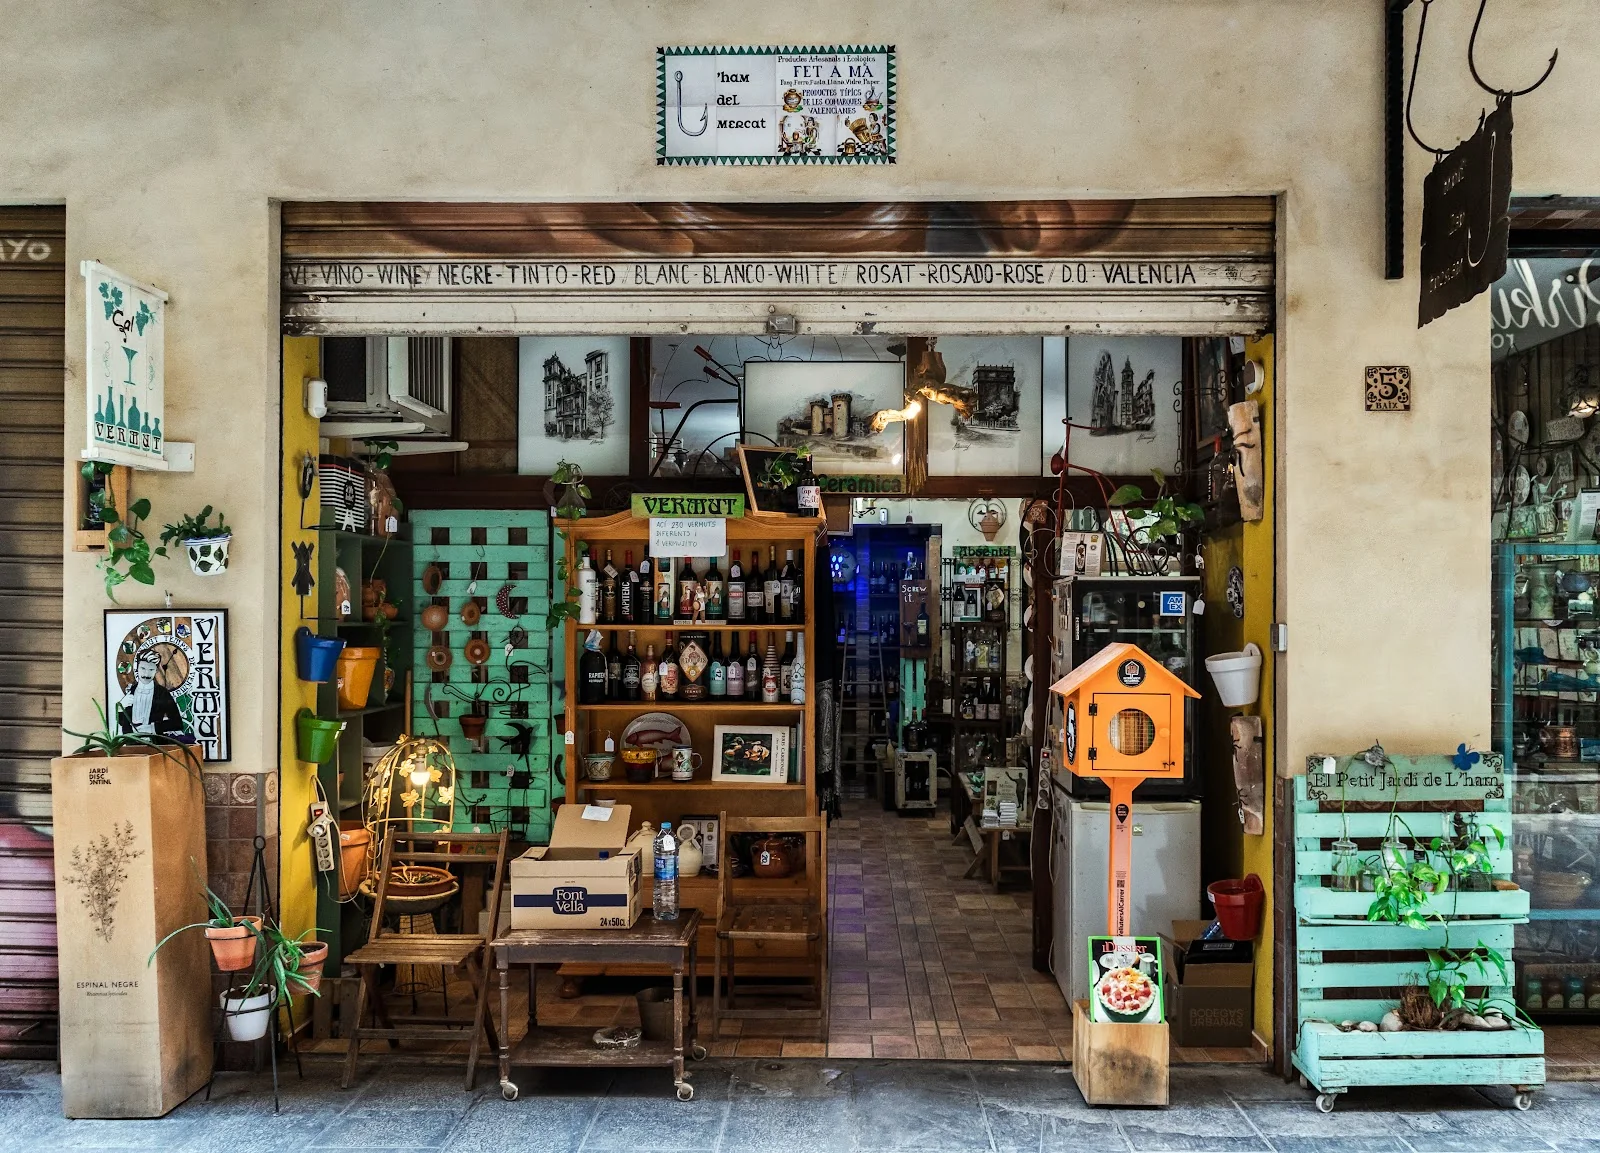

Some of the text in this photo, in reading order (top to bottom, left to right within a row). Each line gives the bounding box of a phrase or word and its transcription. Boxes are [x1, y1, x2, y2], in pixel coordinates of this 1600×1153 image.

[793, 65, 823, 78] FET
[830, 65, 842, 78] A
[802, 89, 837, 97] PRODUCTES
[803, 98, 862, 106] DE LES COMARQUES
[808, 107, 857, 115] VALENCIANES
[1101, 263, 1196, 284] VALENCIA
[1378, 373, 1399, 400] 5
[96, 421, 161, 451] VERMUT
[642, 496, 737, 516] VERMUT
[671, 521, 684, 529] 230
[687, 520, 717, 528] VERMUTS
[621, 581, 630, 615] RAPITENC
[1313, 772, 1330, 788] El
[1336, 771, 1375, 788] Petit
[1424, 772, 1442, 787] de
[555, 889, 584, 901] Font
[555, 901, 585, 913] Vella
[76, 981, 108, 989] ESPINAL
[1190, 1017, 1244, 1027] URBANAS
